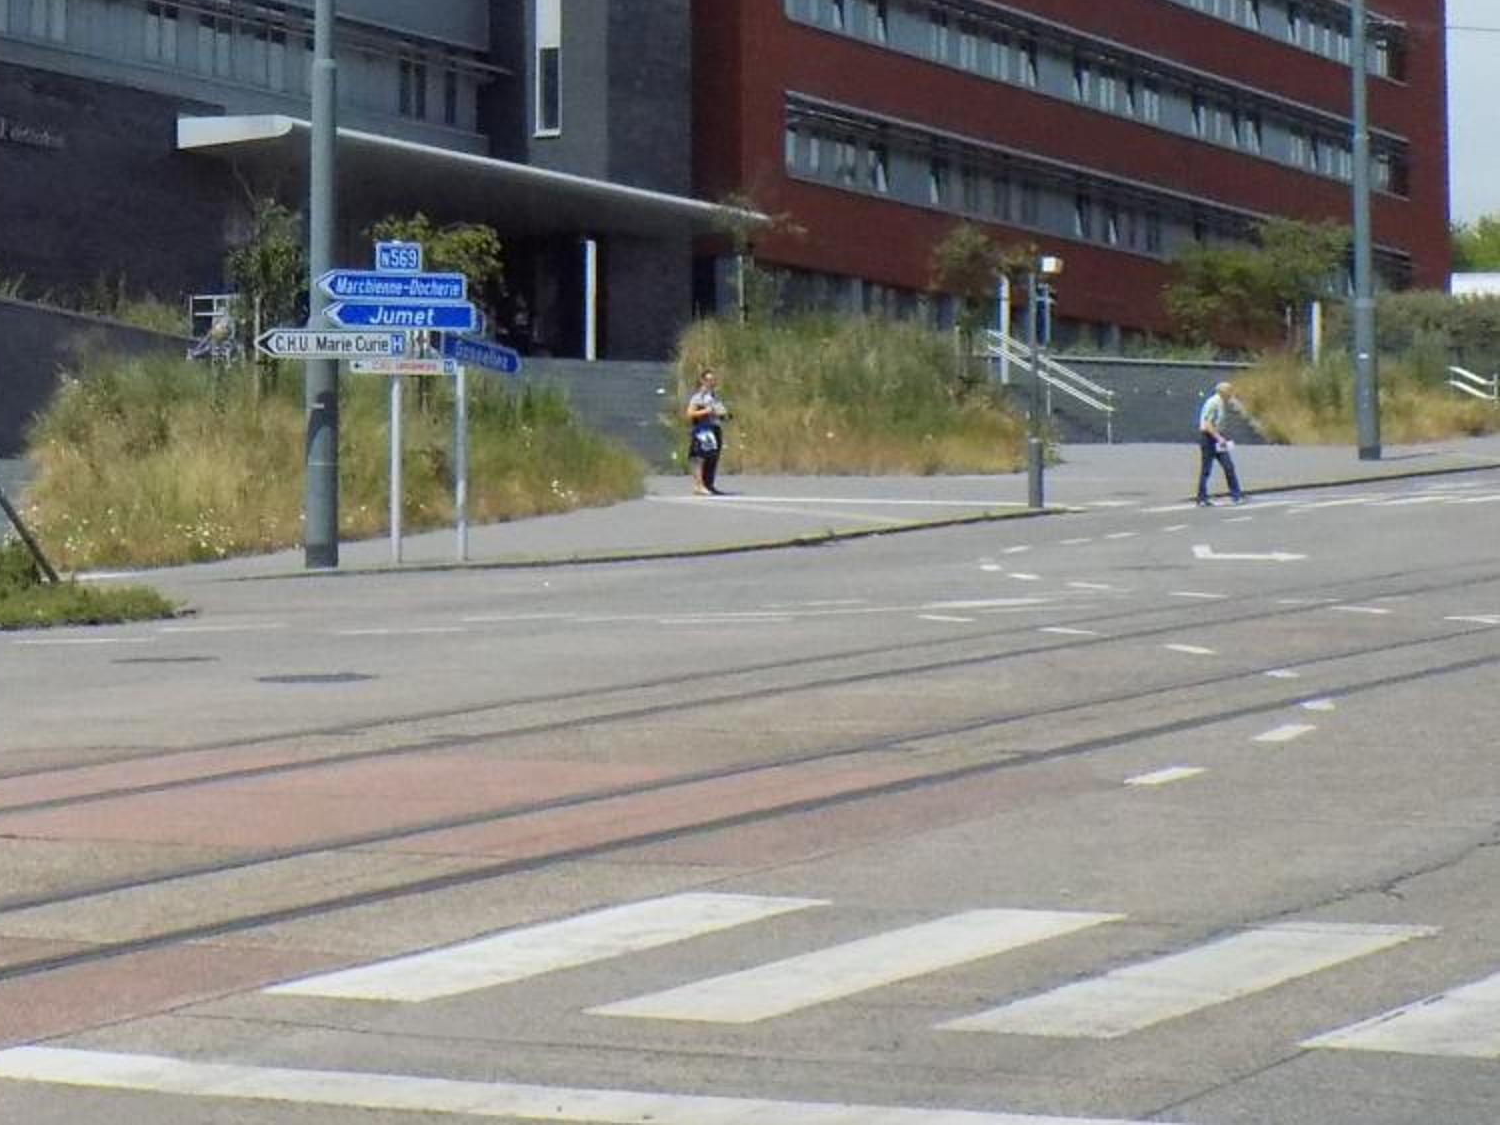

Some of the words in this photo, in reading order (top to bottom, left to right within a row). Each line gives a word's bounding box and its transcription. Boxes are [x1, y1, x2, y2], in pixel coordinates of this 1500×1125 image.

[381, 248, 417, 268] N569
[369, 306, 435, 324] Jumet
[316, 335, 353, 352] Marie
[355, 335, 389, 352] Curie
